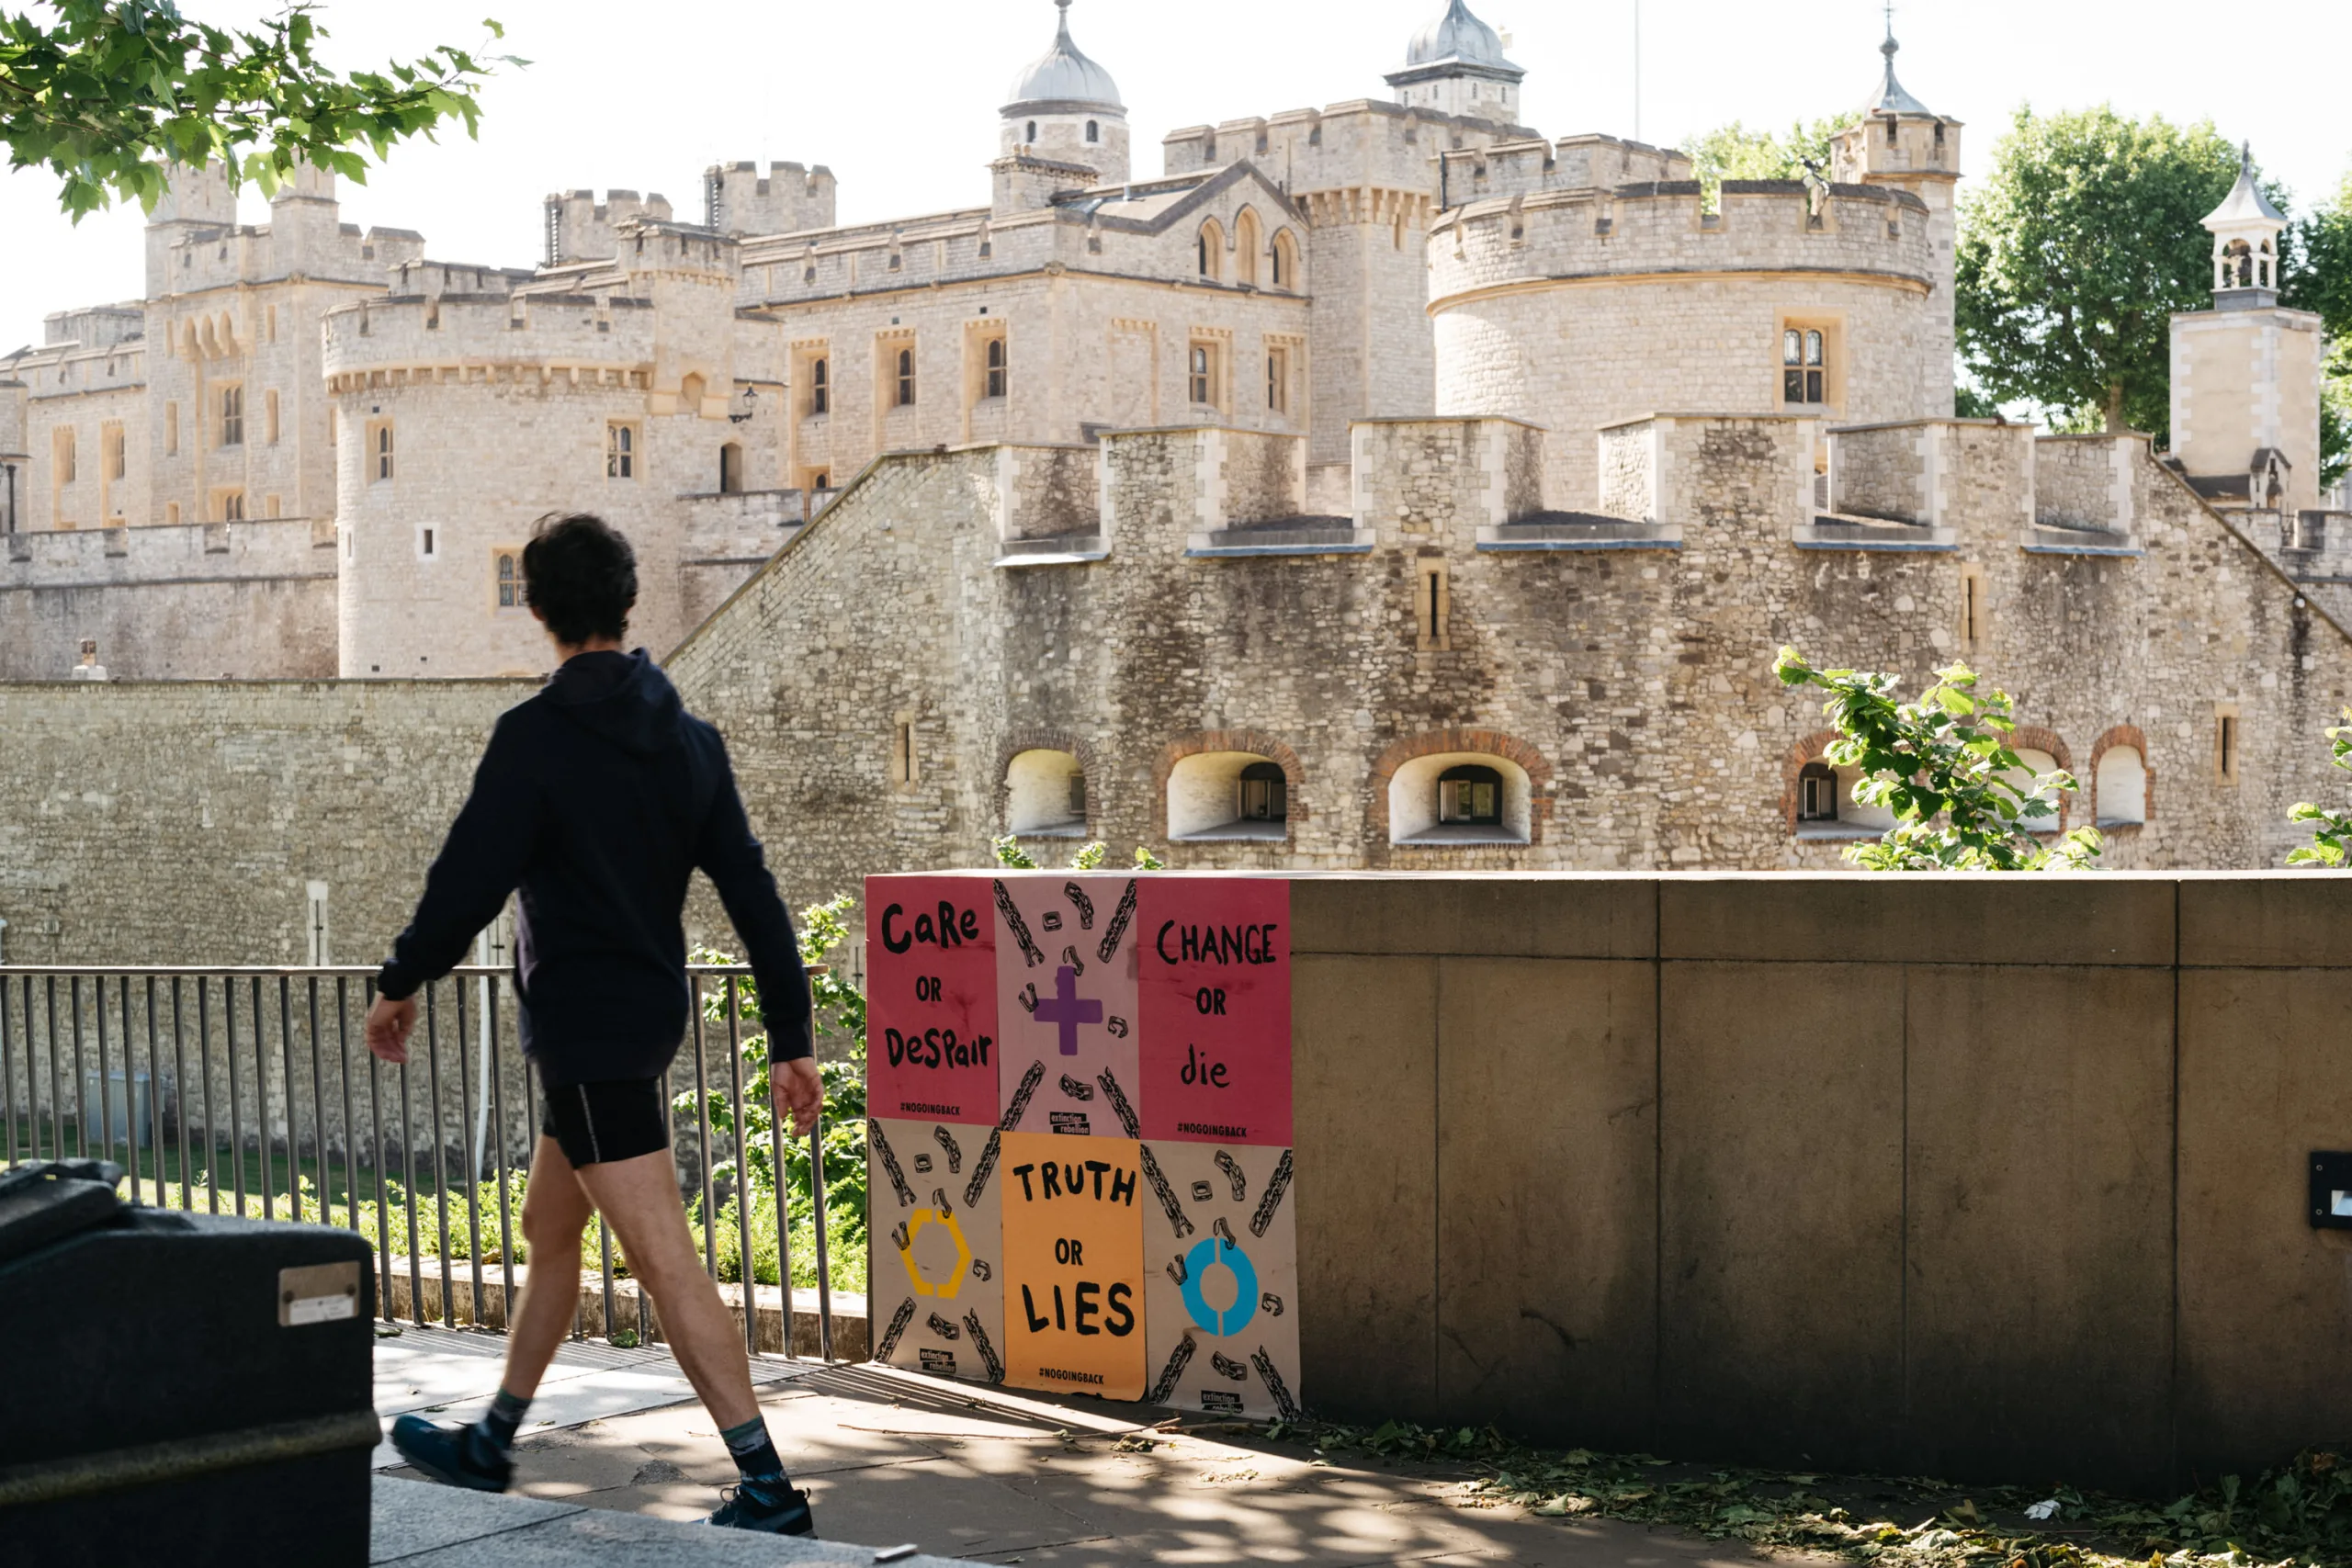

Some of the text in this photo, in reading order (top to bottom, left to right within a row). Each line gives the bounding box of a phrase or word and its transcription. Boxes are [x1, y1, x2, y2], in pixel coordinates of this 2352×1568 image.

[1157, 920, 1277, 964] CHANGE
[916, 976, 941, 1001] OR
[1196, 987, 1226, 1014] OR
[1182, 1044, 1229, 1088] die
[900, 1103, 959, 1114] #NOGOINGBACK
[1051, 1112, 1082, 1122] extinction
[1060, 1123, 1089, 1134] rebellion
[1178, 1123, 1246, 1137] #NOGOINGBACK
[1013, 1161, 1136, 1206] TRUTH
[1056, 1238, 1082, 1265] OR
[1023, 1282, 1134, 1337] LIES
[1039, 1369, 1103, 1384] #NOGOINGBACK
